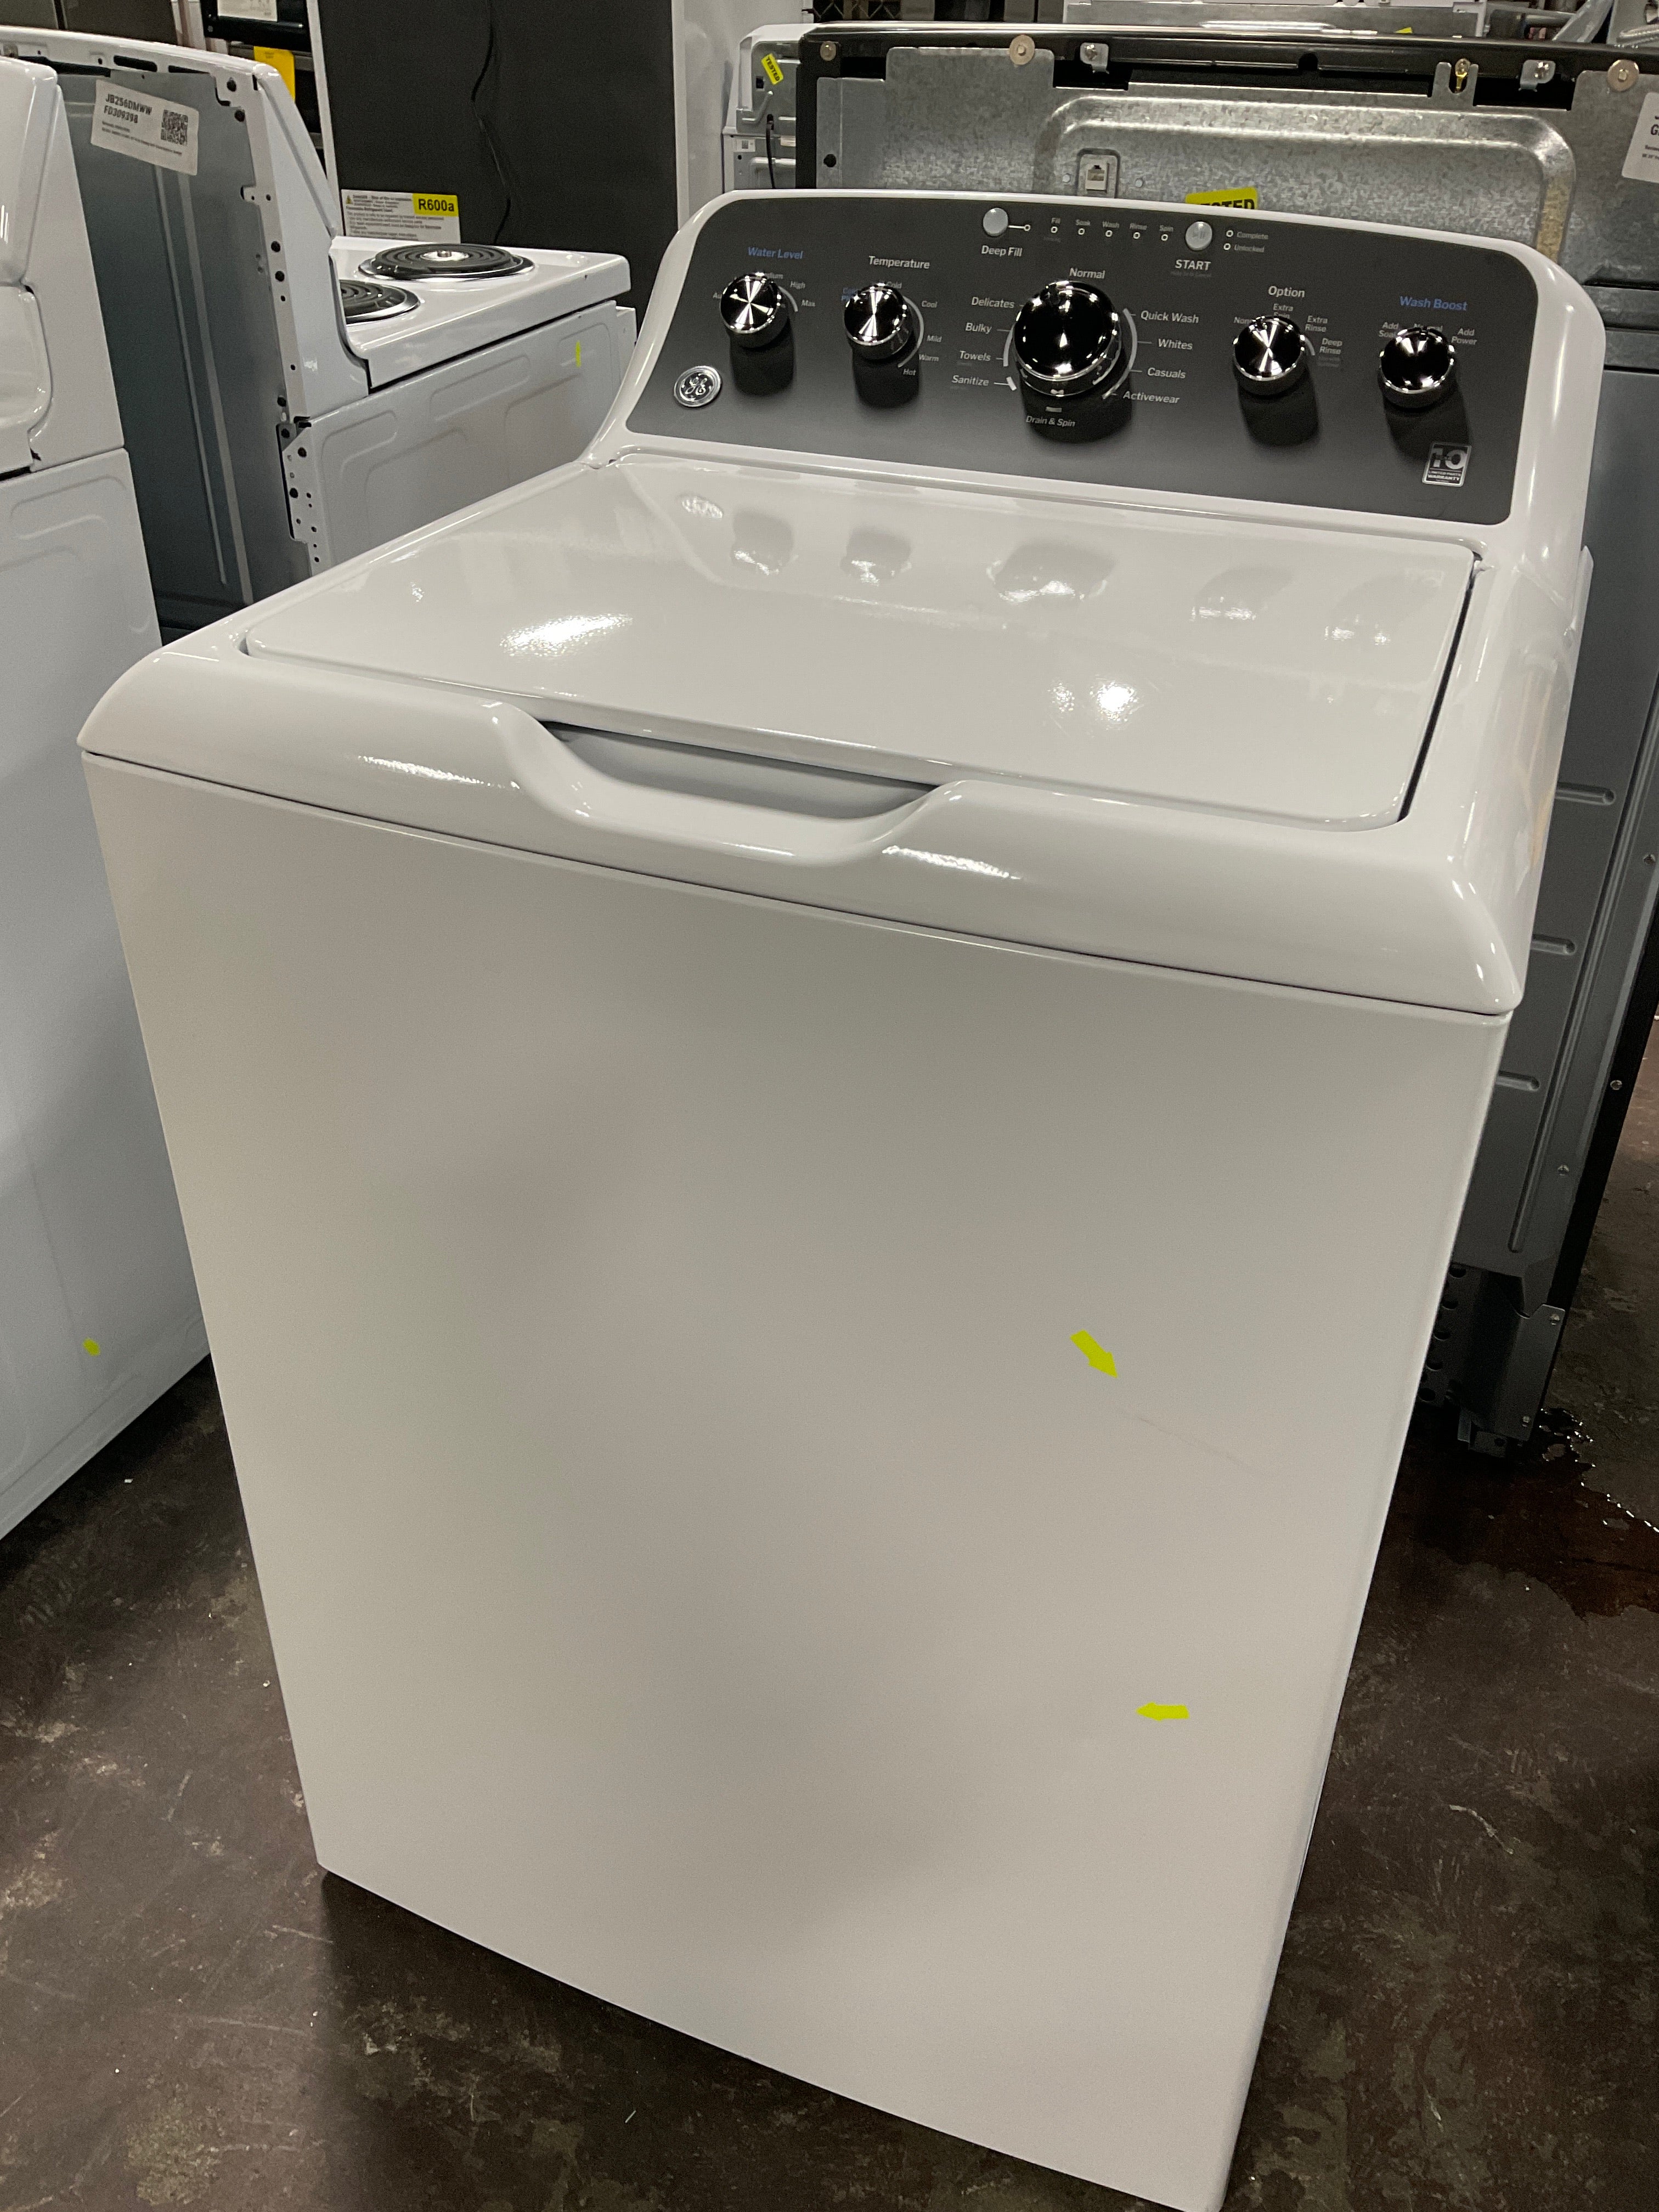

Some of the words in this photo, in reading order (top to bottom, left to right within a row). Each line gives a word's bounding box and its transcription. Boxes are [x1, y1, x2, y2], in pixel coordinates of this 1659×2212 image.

[766, 57, 780, 81] TESTED
[418, 198, 455, 212] R600a
[1102, 221, 1120, 229] Wash
[1237, 231, 1269, 240] Complete
[748, 246, 776, 257] Water
[777, 249, 804, 259] Level
[981, 245, 1006, 257] Deep
[1007, 246, 1023, 257] Fill
[1234, 244, 1265, 253] Unlocked
[868, 255, 930, 269] Temperature
[1175, 259, 1211, 271] START
[1069, 267, 1105, 279] Normal
[790, 281, 806, 290] High
[886, 281, 902, 289] Cold
[1268, 285, 1305, 298] Option
[922, 300, 938, 308] Cool
[971, 296, 1015, 309] Delicates
[1273, 303, 1294, 312] Extra
[1400, 296, 1431, 308] Wash
[1433, 298, 1468, 311] Boost
[1141, 310, 1169, 321] Quick
[1171, 312, 1199, 324] Wash
[1307, 315, 1328, 324] Extra
[965, 322, 992, 334] Bulky
[1305, 324, 1327, 332] Rinse
[1381, 321, 1398, 330] Add
[1458, 328, 1475, 336] Add
[927, 335, 942, 343] Mild
[1158, 338, 1193, 350] Whites
[1322, 338, 1343, 347] Deep
[1452, 336, 1477, 345] Power
[1319, 346, 1341, 354] Rinse
[918, 354, 939, 362] Warm
[960, 351, 992, 362] Towels
[1147, 367, 1186, 379] Casuals
[952, 375, 990, 386] Sanitize
[1123, 391, 1180, 404] Activewear
[1025, 415, 1048, 425] Drain
[1057, 419, 1076, 428] Spin
